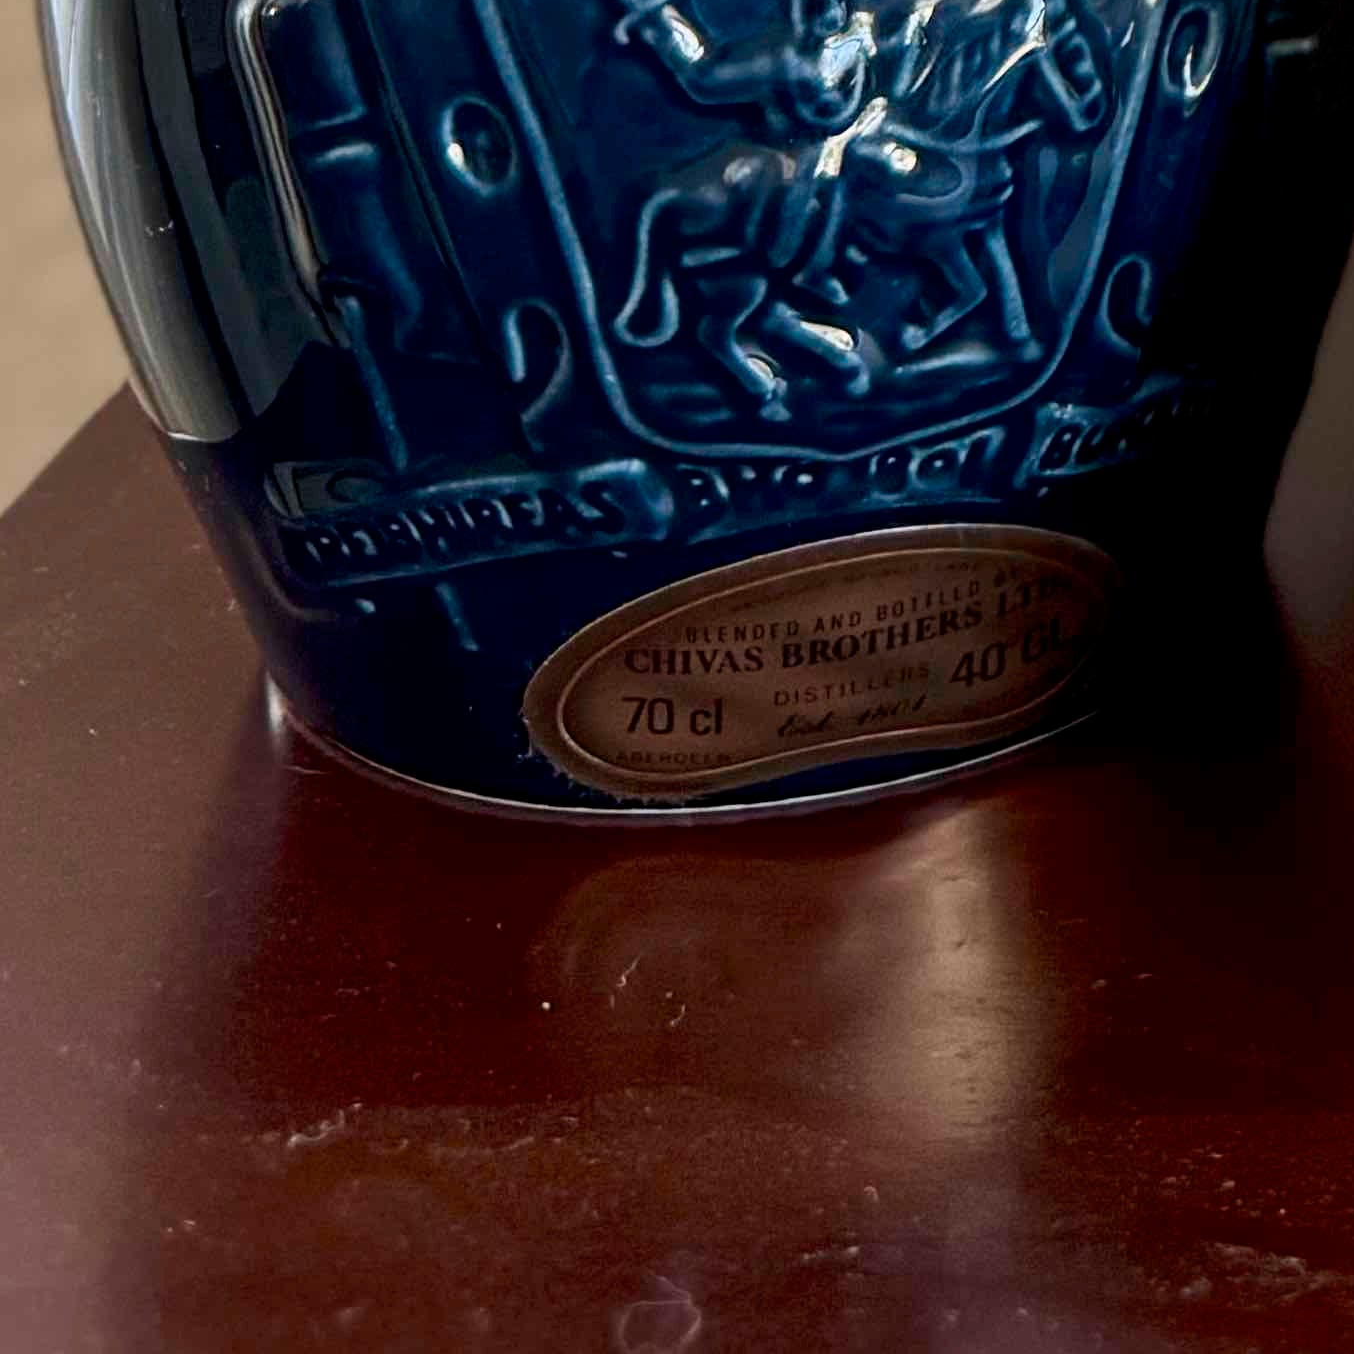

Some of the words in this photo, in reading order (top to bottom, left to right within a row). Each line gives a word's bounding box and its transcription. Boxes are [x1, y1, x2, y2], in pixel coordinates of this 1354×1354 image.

[623, 646, 765, 675] CHIVAS
[780, 601, 984, 669] BROTHERS
[812, 610, 862, 632] AND
[772, 663, 932, 708] DISTILLERS
[620, 695, 675, 734] 70
[689, 697, 724, 736] cl
